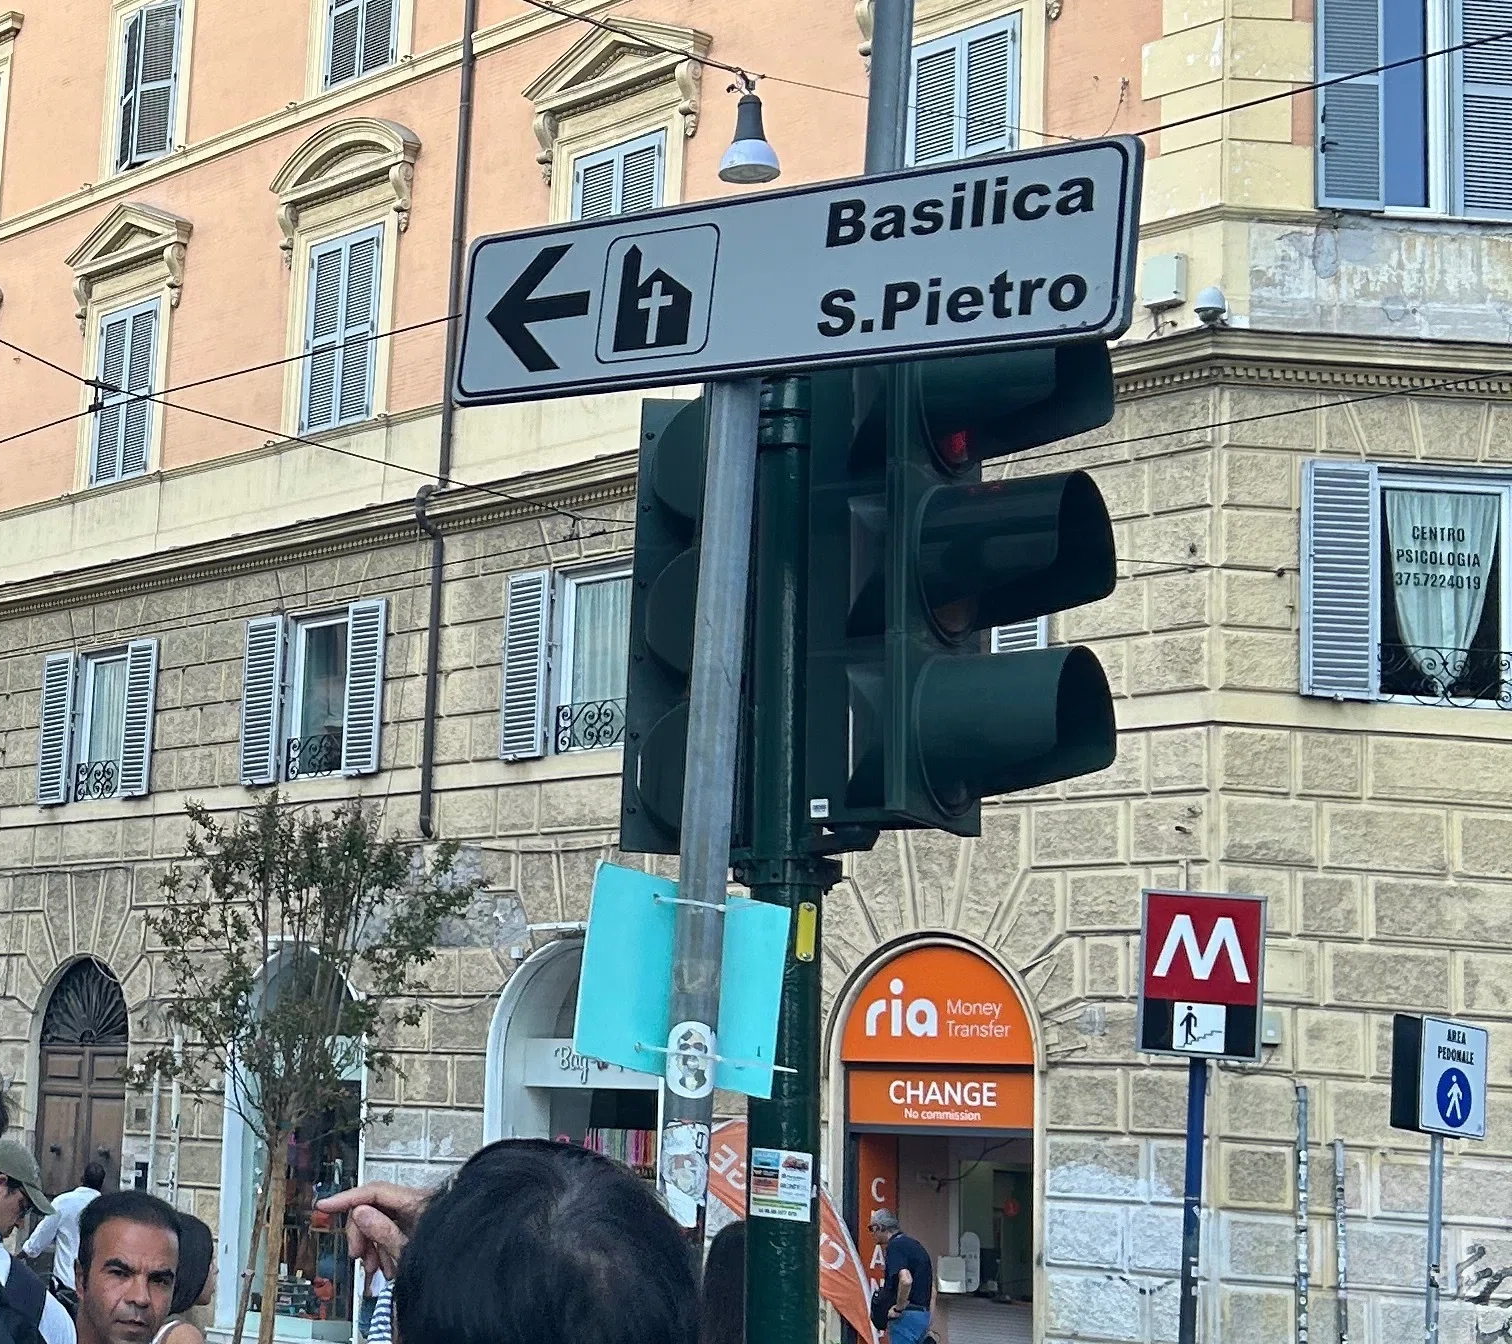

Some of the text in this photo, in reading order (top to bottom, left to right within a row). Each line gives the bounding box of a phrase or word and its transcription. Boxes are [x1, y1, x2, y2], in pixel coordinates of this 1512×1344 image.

[824, 175, 1095, 249] Basilica
[816, 268, 1088, 338] S.Pietro
[1411, 524, 1466, 543] CENTRO
[1395, 548, 1482, 568] PSICOLOGIA
[1151, 913, 1251, 985] M
[865, 977, 939, 1038] ria
[946, 998, 1003, 1020] Money
[946, 1019, 1011, 1038] Transfer
[1446, 1028, 1467, 1045] AREA
[1437, 1045, 1475, 1066] PEDONALE
[888, 1079, 998, 1107] CHANGE
[903, 1107, 982, 1122] No commission
